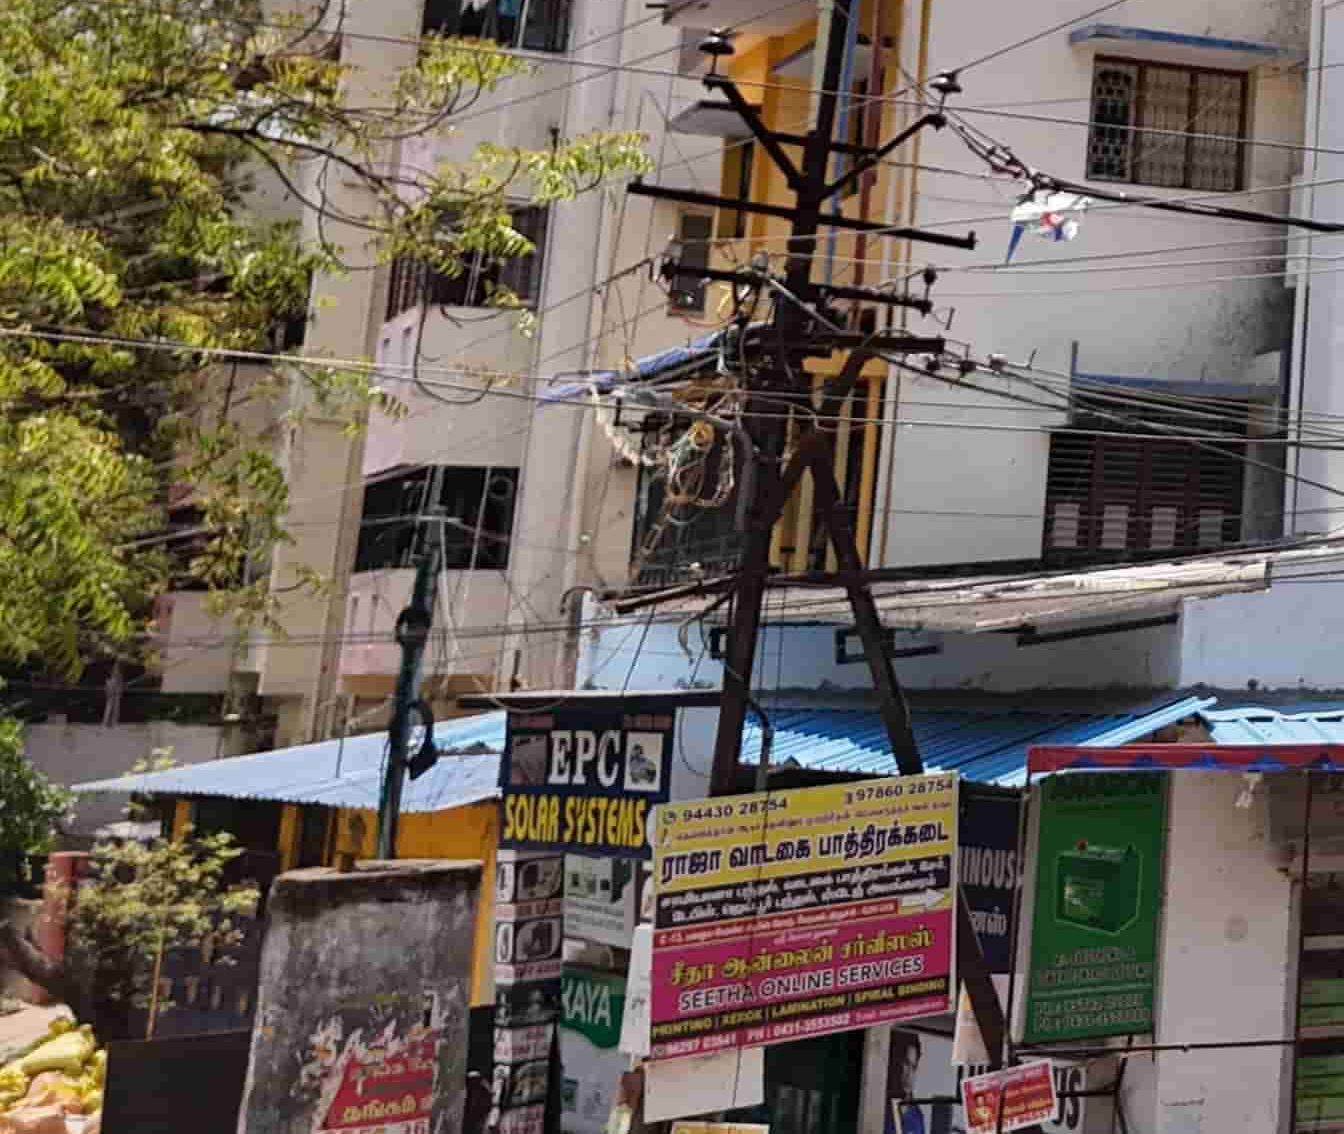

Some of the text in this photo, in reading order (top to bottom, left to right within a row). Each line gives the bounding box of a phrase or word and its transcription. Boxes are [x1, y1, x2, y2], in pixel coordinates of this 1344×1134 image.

[548, 729, 622, 786] EPC
[503, 793, 561, 842] SOLAR
[563, 796, 646, 847] SYSTEMS
[660, 849, 722, 885] ராஜா
[729, 838, 811, 868] வாடகை
[818, 819, 949, 860] பாத்திரக்கடை
[679, 954, 924, 1011] SEETHA ONLINE SERVICES
